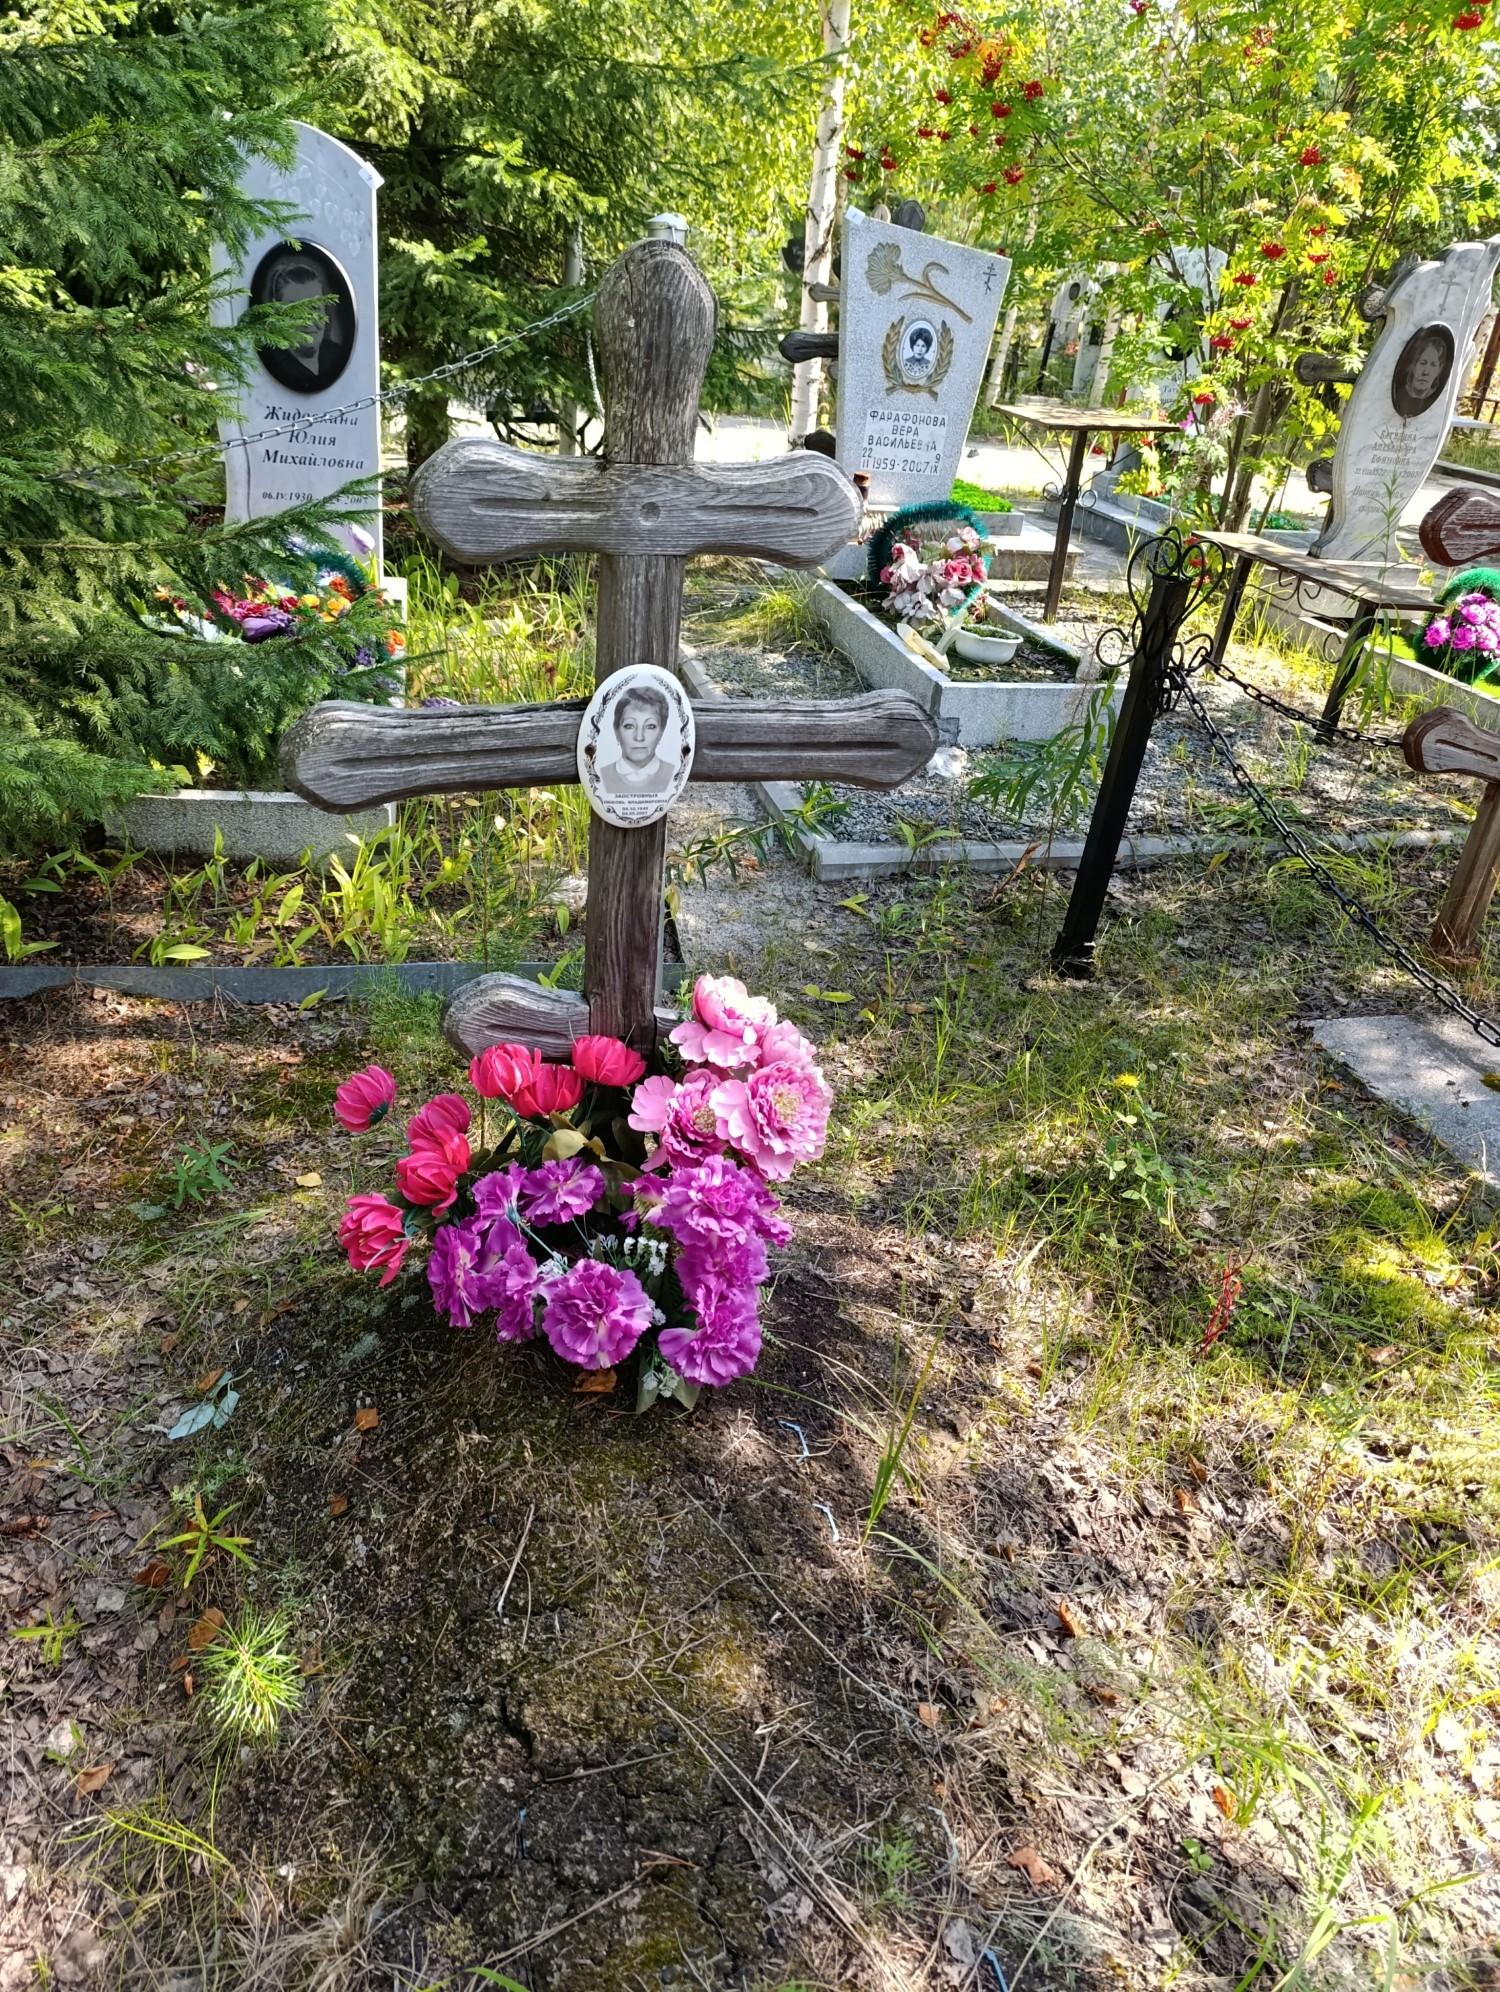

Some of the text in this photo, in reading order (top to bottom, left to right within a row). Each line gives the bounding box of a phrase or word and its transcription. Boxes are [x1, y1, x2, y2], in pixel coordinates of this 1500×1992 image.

[869, 410, 946, 427] ФАРАФОНОВА
[288, 430, 337, 447] Юлия
[892, 424, 919, 438] ВЕРА
[262, 448, 364, 470] Михайловна
[862, 446, 873, 458] 22
[934, 453, 941, 464] 9
